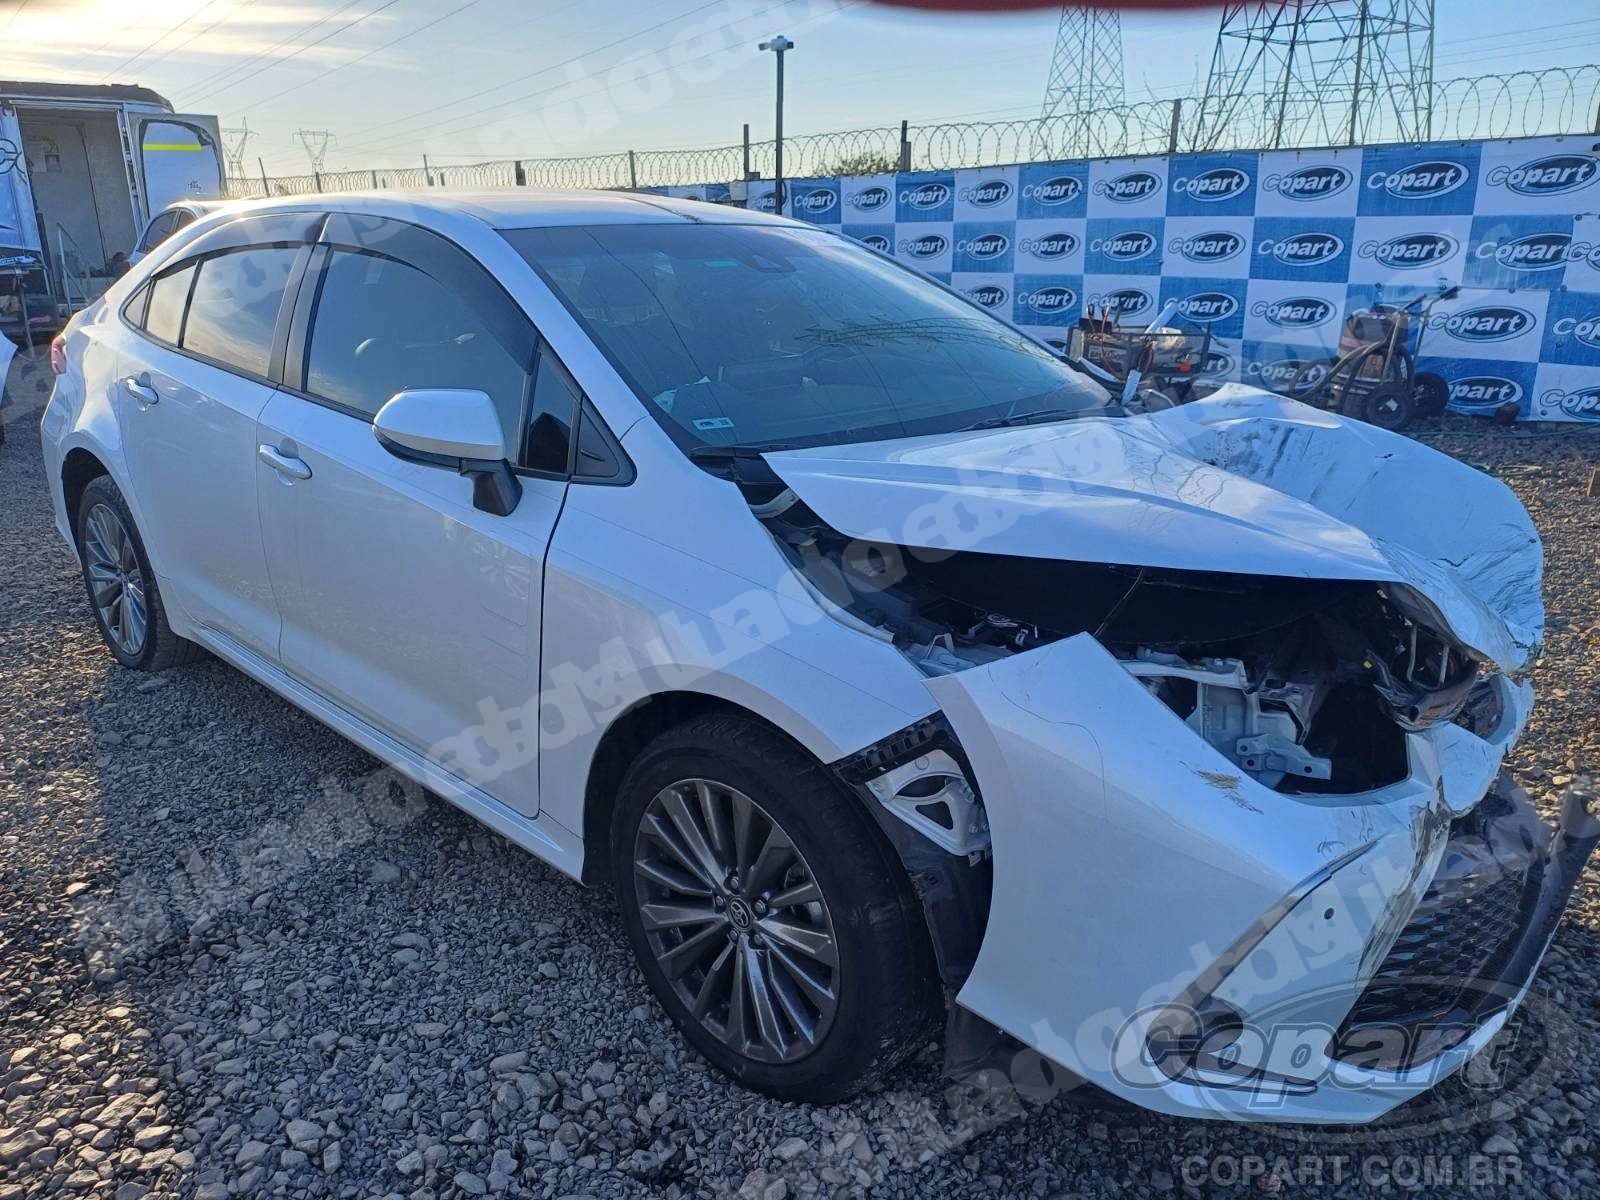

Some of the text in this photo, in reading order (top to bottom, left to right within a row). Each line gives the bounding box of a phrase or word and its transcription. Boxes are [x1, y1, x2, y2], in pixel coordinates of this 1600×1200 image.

[1173, 173, 1241, 194] Copart
[1263, 171, 1341, 193] Copart
[1366, 167, 1457, 191] Copart
[1485, 163, 1590, 187] Copart
[900, 187, 945, 207] Copart
[958, 185, 1007, 204] Copart
[1022, 182, 1075, 200] Copart
[794, 193, 833, 210] Copart
[898, 237, 943, 256] Copart
[957, 237, 1004, 256] Copart
[1018, 237, 1072, 257] Copart
[1090, 237, 1150, 257] Copart
[1168, 237, 1236, 258] Copart
[1258, 239, 1334, 260] Copart
[1358, 240, 1447, 261] Copart
[1017, 292, 1070, 308] Copart
[1250, 301, 1326, 320] Copart
[1427, 312, 1521, 335] Copart
